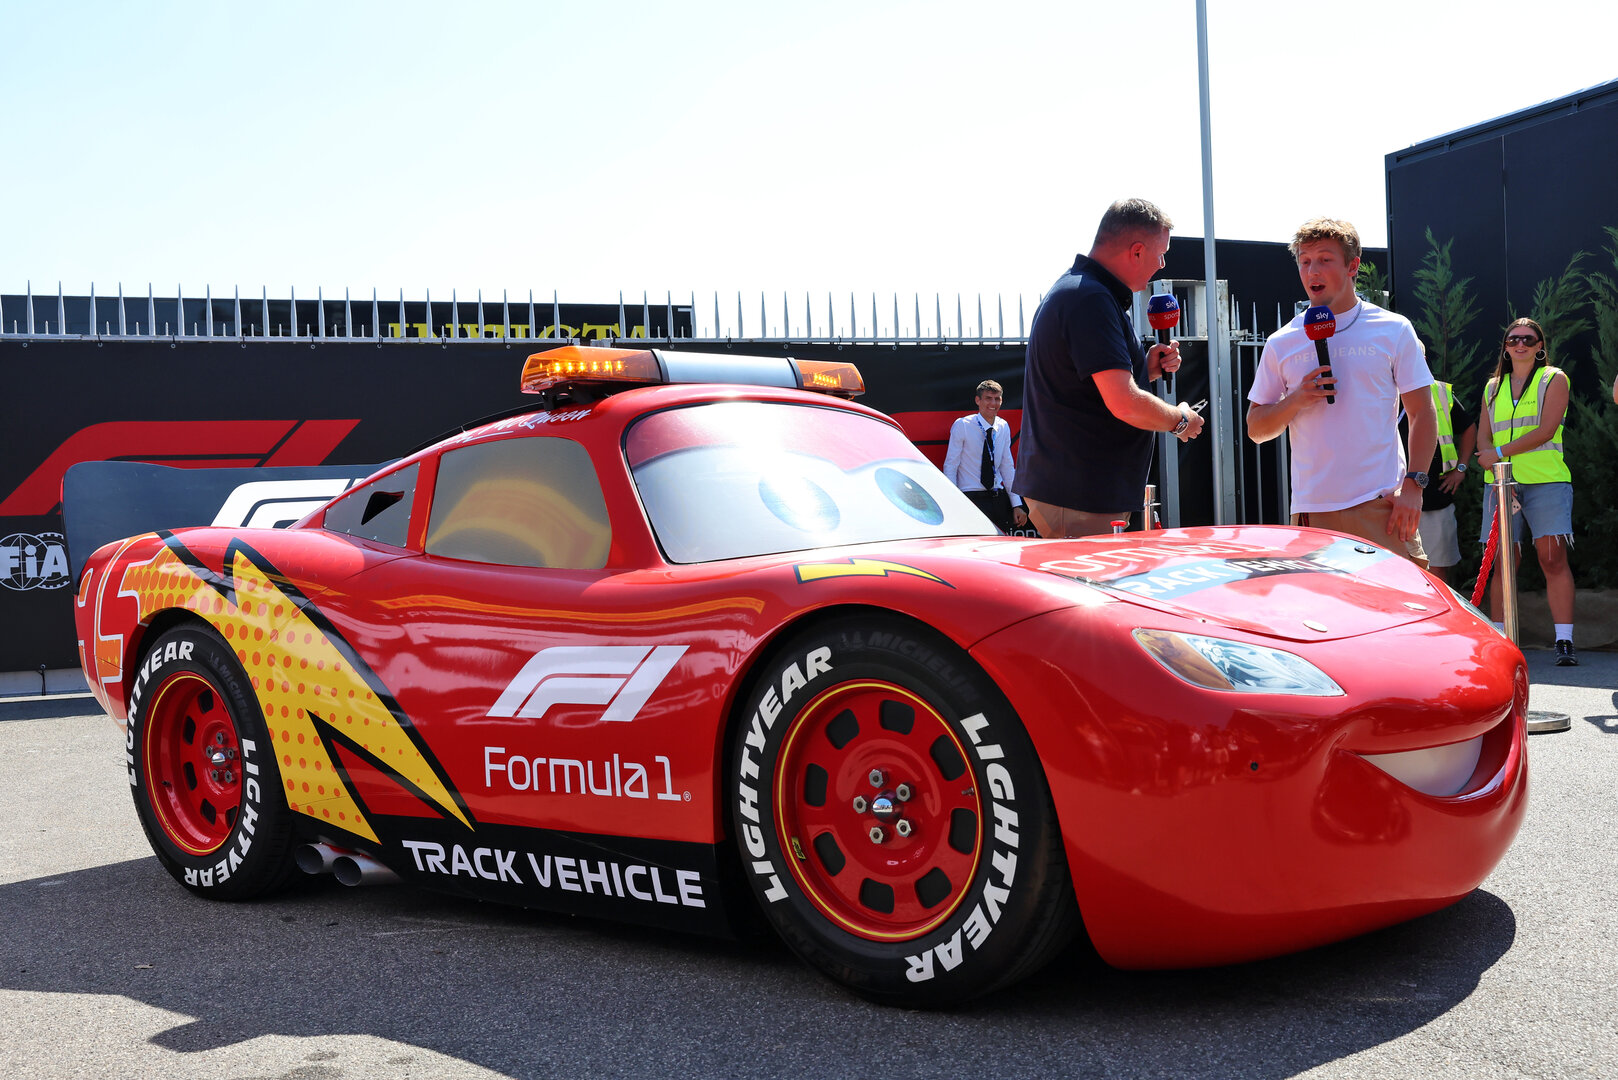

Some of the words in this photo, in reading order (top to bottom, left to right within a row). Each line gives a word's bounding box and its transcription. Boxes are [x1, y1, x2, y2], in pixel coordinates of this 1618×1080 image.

[1313, 321, 1335, 332] sports
[1315, 311, 1329, 320] sky
[1332, 345, 1377, 359] JEANS
[739, 646, 834, 903] LIGHTYEAR
[184, 737, 261, 888] LIGHTYEAR
[402, 839, 523, 885] TRACK
[526, 852, 706, 908] VEHICLE
[904, 712, 1020, 983] LIGHTYEAR
